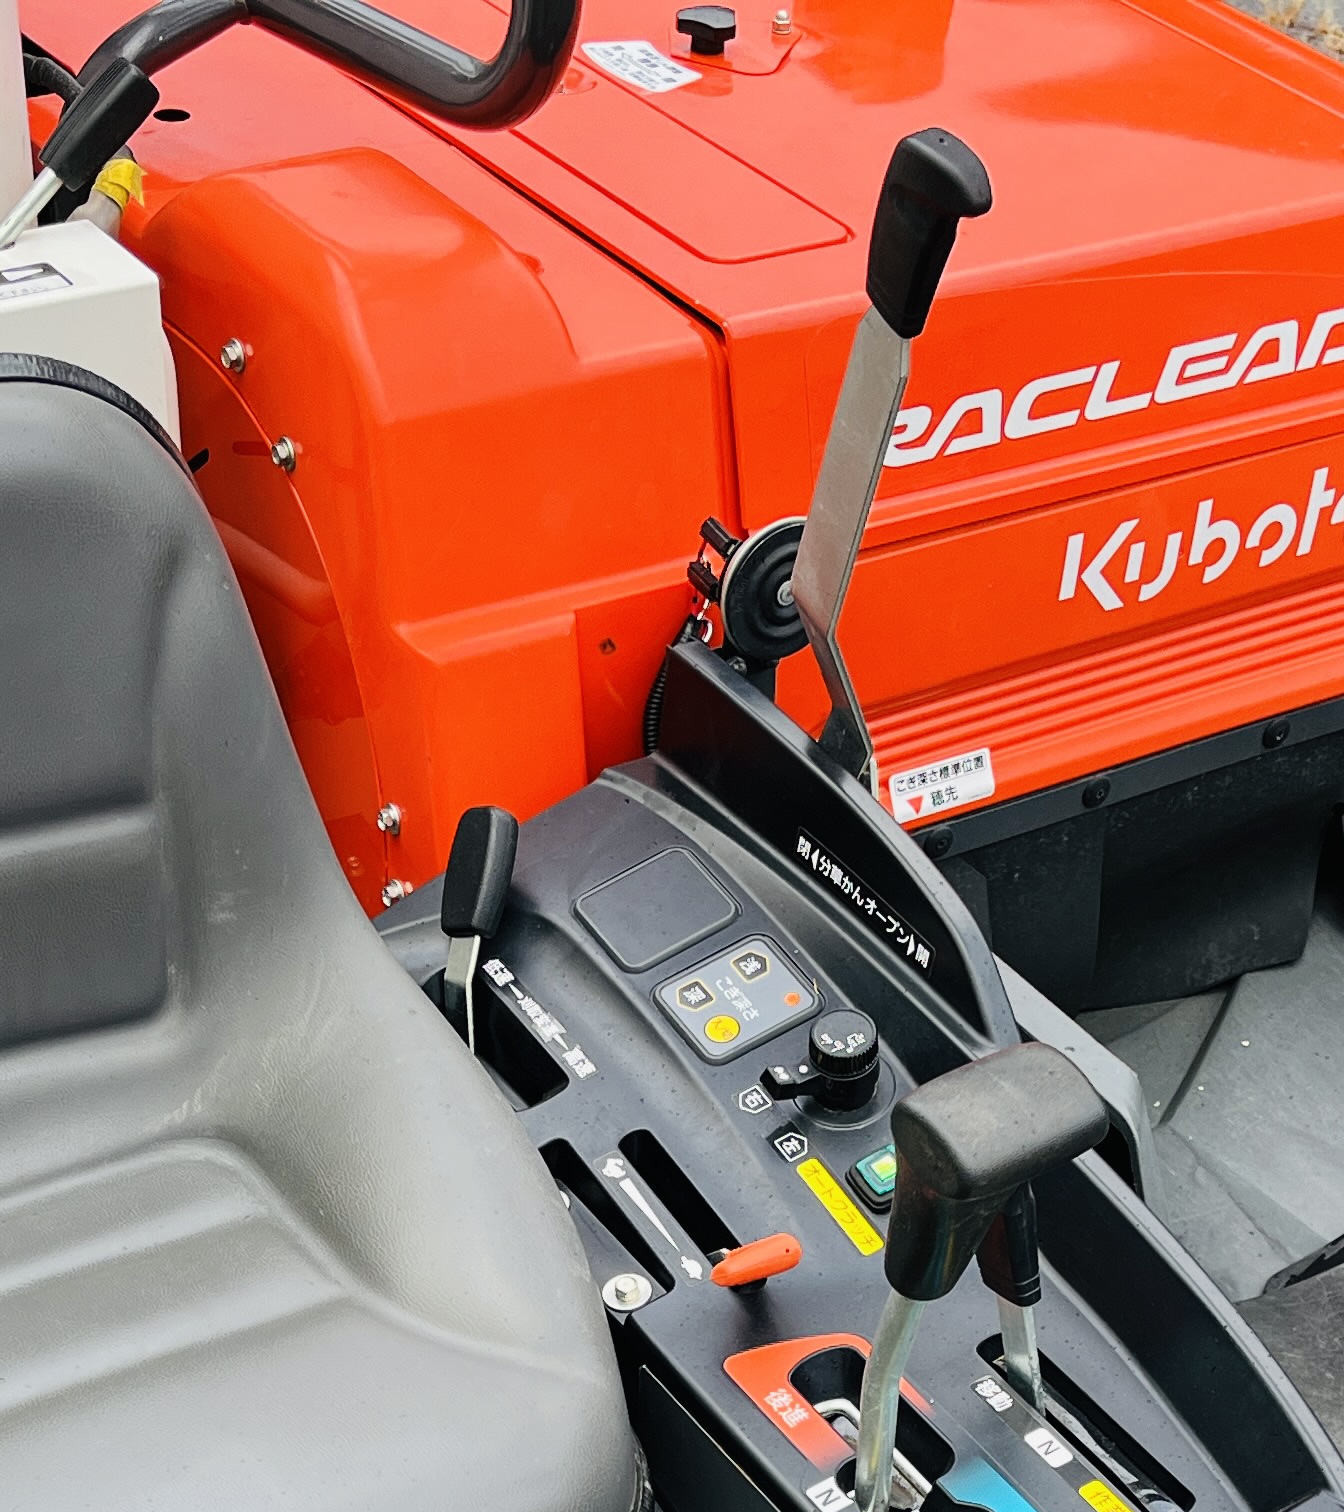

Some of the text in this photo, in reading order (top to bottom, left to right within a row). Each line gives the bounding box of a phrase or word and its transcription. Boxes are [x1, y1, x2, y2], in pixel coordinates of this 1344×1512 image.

[896, 755, 984, 792] こぎ深さ標準位置
[930, 785, 959, 808] 穂先
[716, 976, 760, 1021] こぎ深さ
[743, 1087, 765, 1110] 右
[782, 1136, 803, 1158] 左
[801, 1162, 878, 1252] オートクラッチ
[763, 1388, 811, 1429] 後進
[974, 1377, 1014, 1412] 移動
[1036, 1437, 1062, 1459] N
[813, 1488, 844, 1508] N
